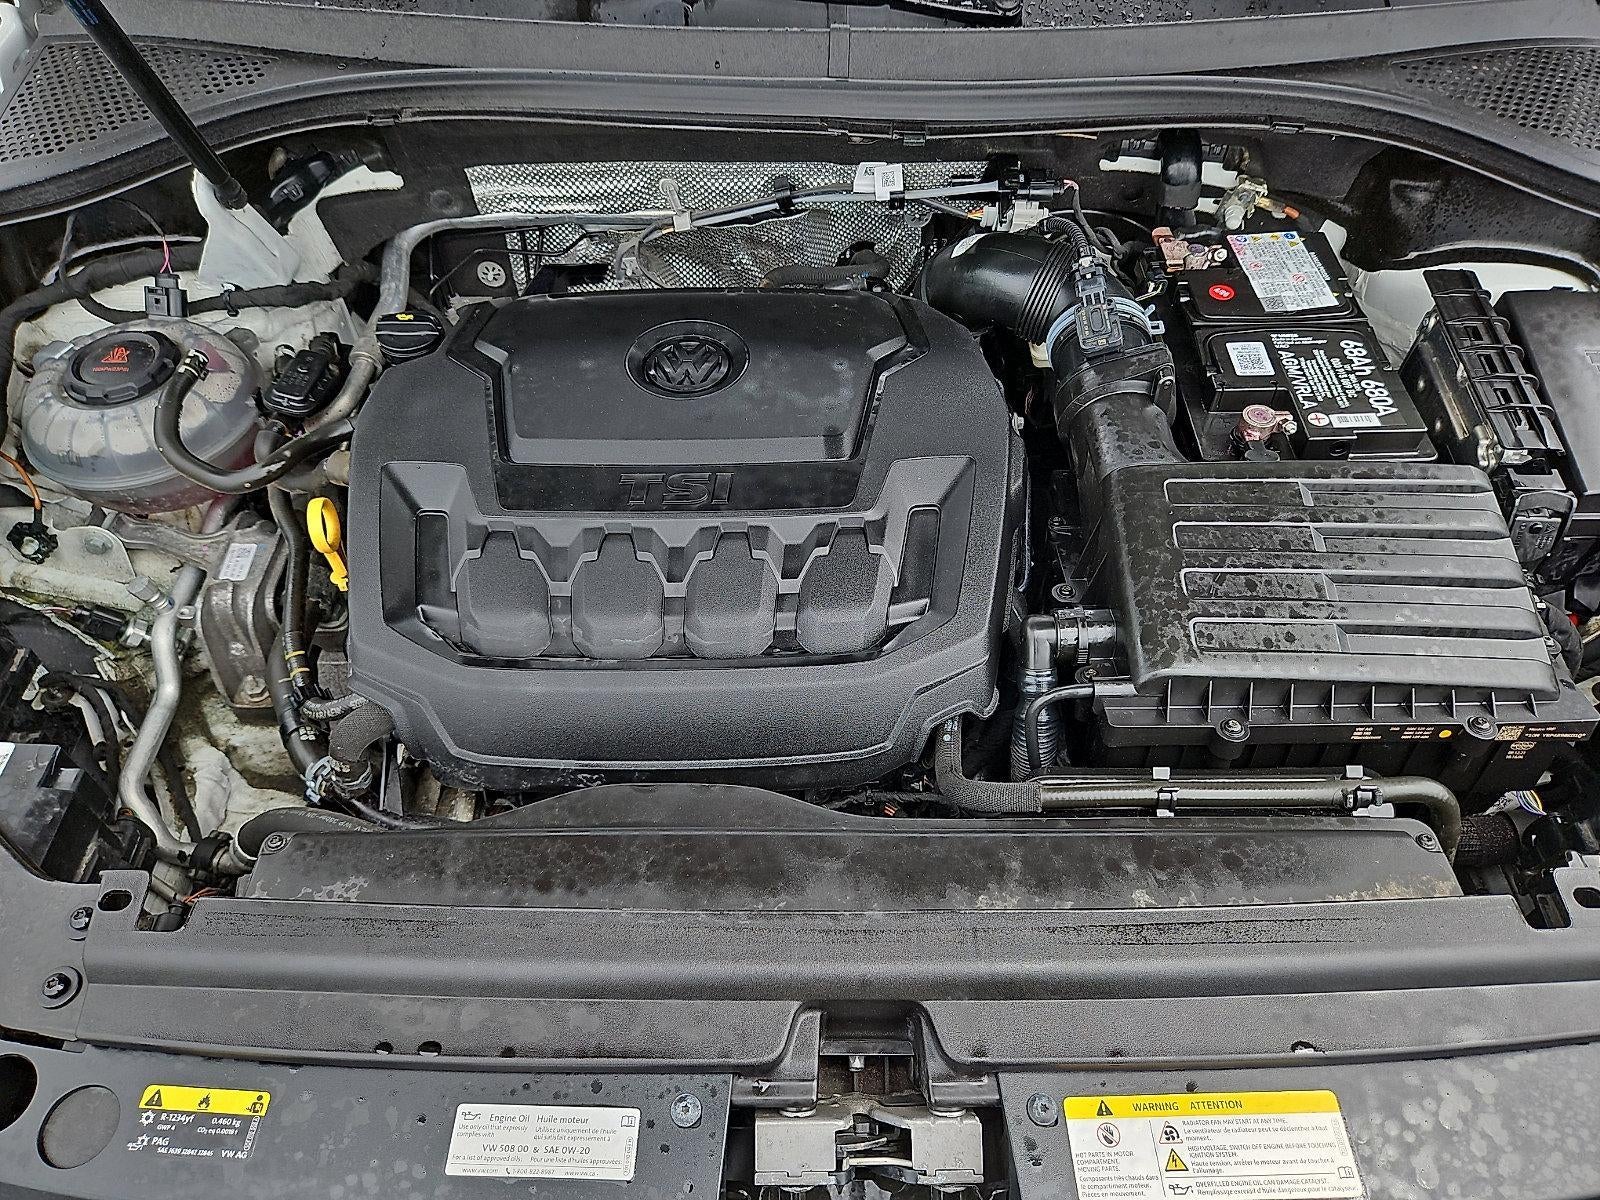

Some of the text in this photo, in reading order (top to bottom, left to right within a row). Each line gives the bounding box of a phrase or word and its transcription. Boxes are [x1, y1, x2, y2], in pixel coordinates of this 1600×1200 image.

[644, 335, 731, 392] VW
[1278, 350, 1318, 410] AGM/VRLA
[1340, 340, 1376, 376] 68Ah
[1360, 380, 1399, 417] 680A
[619, 472, 734, 505] TSI
[1132, 1099, 1243, 1112] WARNING ATTENTION
[160, 1113, 242, 1128] R-1234yf 0.460 kg
[489, 1113, 530, 1124] Engine Oil
[536, 1115, 558, 1123] Huile
[469, 1123, 481, 1131] only
[502, 1124, 528, 1133] expressly
[556, 1127, 591, 1135] uniquement
[151, 1136, 170, 1146] PAG
[482, 1144, 498, 1152] VW
[499, 1144, 516, 1152] 508
[517, 1145, 529, 1153] 00
[543, 1145, 560, 1154] SAE
[221, 1150, 235, 1158] VW
[235, 1150, 248, 1159] AG
[483, 1155, 510, 1163] approved
